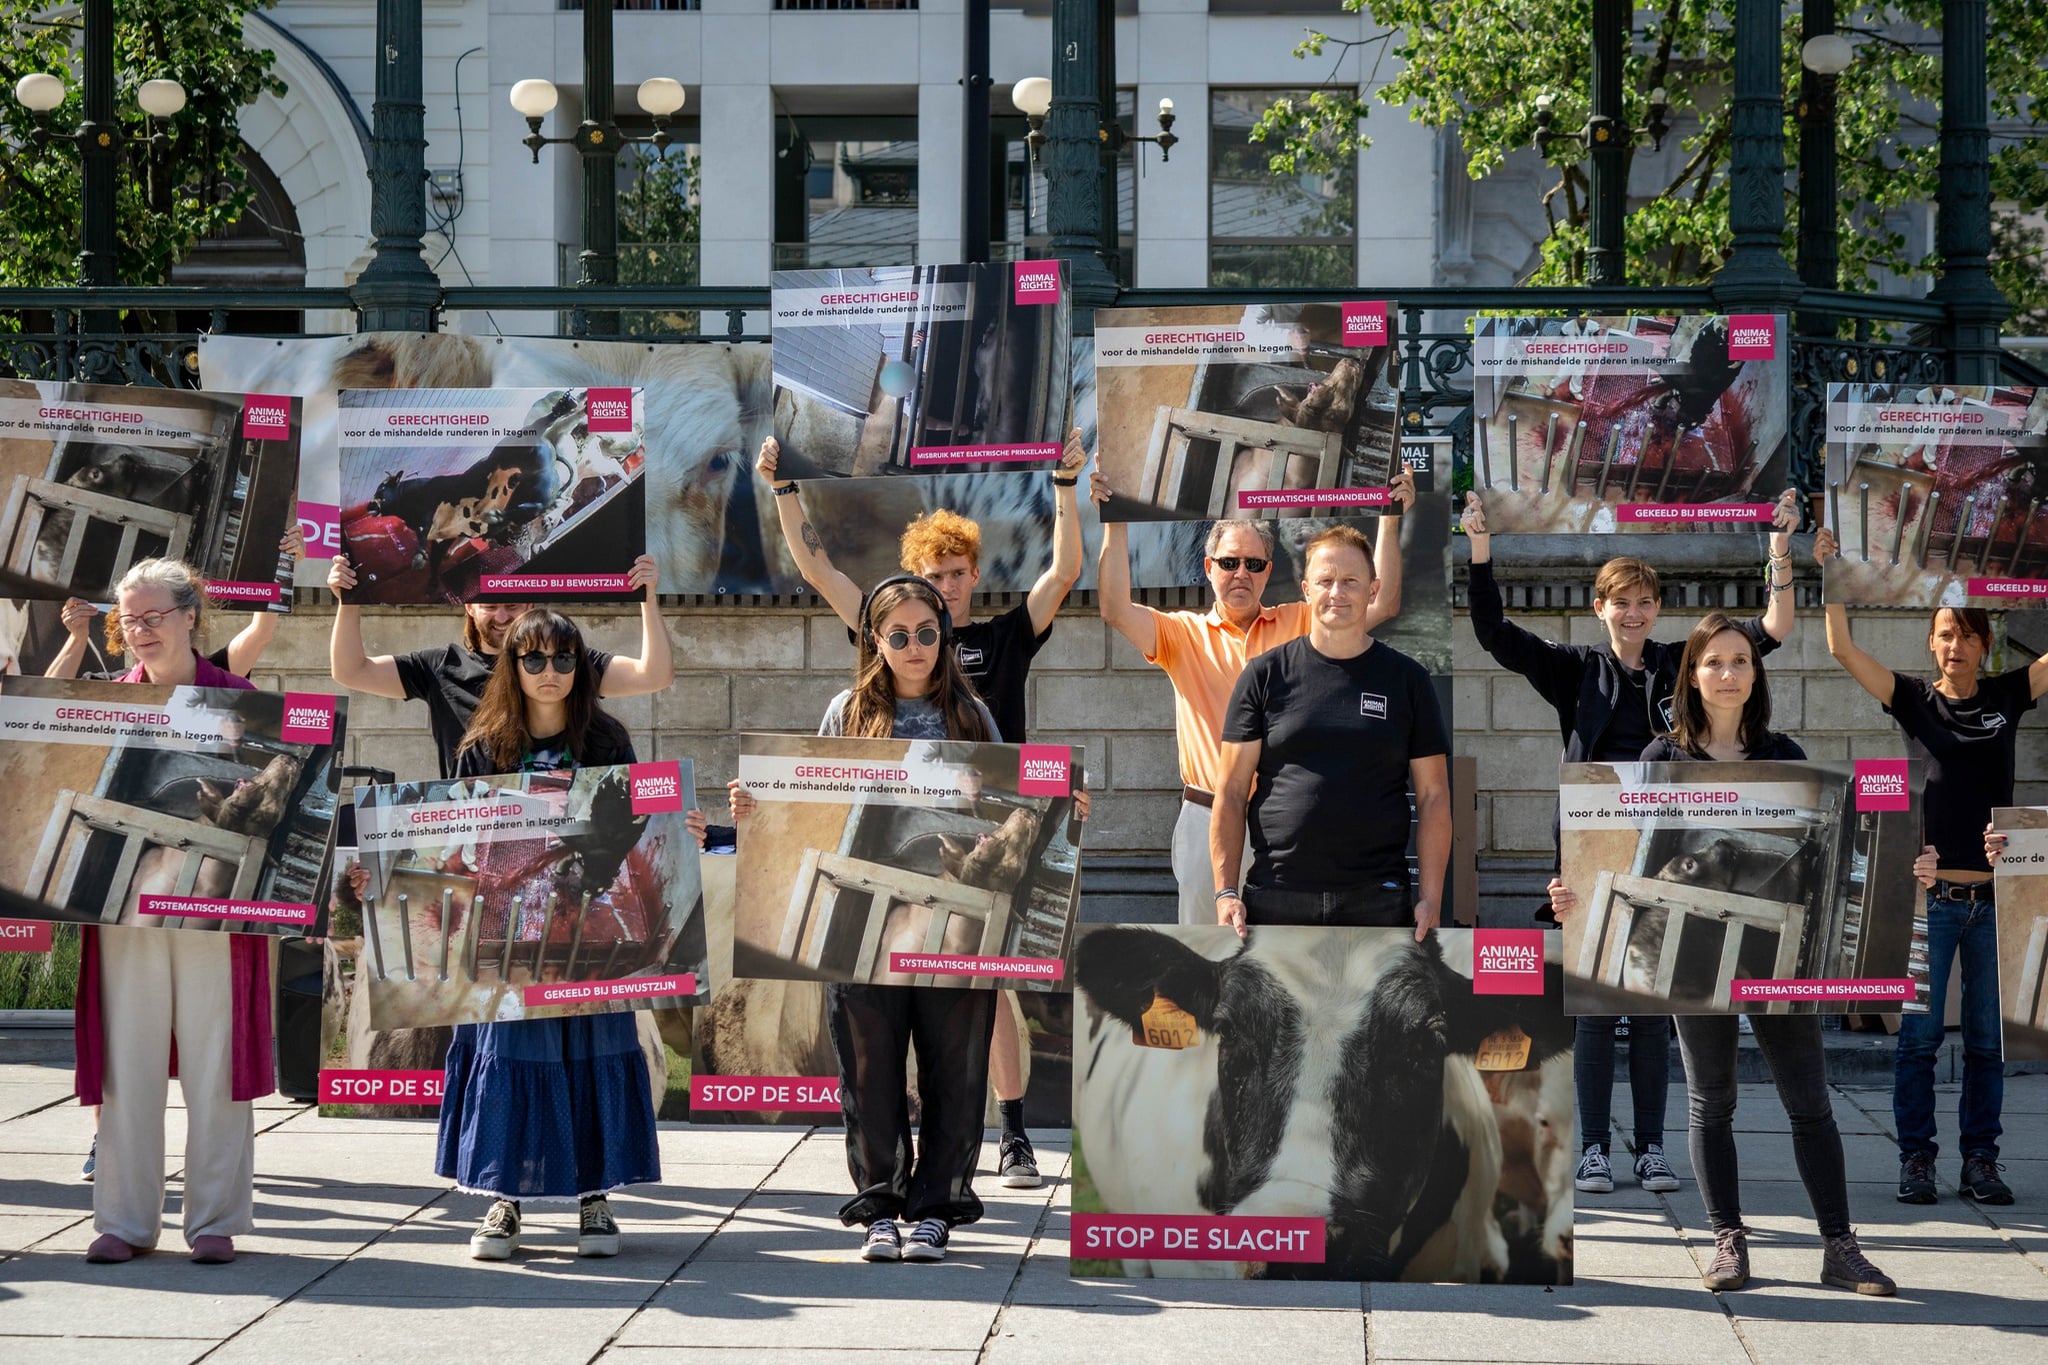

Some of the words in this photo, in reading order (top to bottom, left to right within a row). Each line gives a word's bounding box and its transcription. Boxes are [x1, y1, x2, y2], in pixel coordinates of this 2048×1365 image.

[1019, 273, 1056, 282] ANIMAL
[1021, 281, 1054, 289] RIGHTS
[820, 291, 919, 305] GERECHTIGHEID
[778, 309, 799, 317] voor
[802, 307, 813, 316] de
[816, 305, 874, 316] mishandelde
[876, 304, 918, 313] runderen
[921, 304, 929, 312] in
[933, 303, 966, 313] Izegem
[1346, 315, 1383, 323] ANIMAL
[1348, 322, 1382, 331] RIGHTS
[1145, 332, 1245, 344] GERECHTIGHEID
[1732, 329, 1771, 337] ANIMAL
[1734, 336, 1769, 344] RIGHTS
[1102, 349, 1123, 357] voor
[1126, 347, 1138, 356] de
[1141, 346, 1199, 356] mishandelde
[1202, 345, 1244, 354] runderen
[1247, 345, 1256, 353] in
[1259, 344, 1292, 354] Izegem
[1525, 343, 1628, 354] GERECHTIGHEID
[1506, 357, 1518, 366] de
[1521, 356, 1580, 365] mishandelde
[1584, 357, 1627, 365] runderen
[1630, 357, 1639, 365] in
[1642, 357, 1677, 366] Izegem
[591, 401, 628, 410] ANIMAL
[39, 407, 143, 423] GERECHTIGHEID
[249, 407, 287, 417] ANIMAL
[593, 409, 627, 417] RIGHTS
[1879, 411, 1983, 423] GERECHTIGHEID
[250, 415, 284, 424] RIGHTS
[388, 414, 489, 426] GERECHTIGHEID
[18, 420, 30, 428] de
[33, 421, 94, 432] mishandelde
[98, 425, 141, 436] runderen
[144, 427, 153, 436] in
[156, 429, 191, 439] Izegem
[344, 430, 366, 438] voor
[368, 428, 381, 438] de
[383, 427, 443, 437] mishandelde
[446, 428, 488, 437] runderen
[491, 428, 500, 436] in
[503, 428, 537, 438] Izegem
[1859, 424, 1871, 433] de
[1874, 424, 1935, 434] mishandelde
[1938, 426, 1982, 435] runderen
[1985, 427, 1994, 435] in
[1998, 428, 2033, 438] Izegem
[1011, 448, 1055, 456] PRIKKELAARS
[1247, 495, 1315, 503] SYSTEMATISCHE
[1317, 493, 1382, 501] MISHANDELING
[1635, 509, 1678, 517] GEKEELD
[1681, 509, 1695, 517] BIJ
[1697, 509, 1756, 517] BEWUSTZIJN
[488, 579, 548, 588] OPGETAKELD
[550, 579, 564, 587] BIJ
[567, 579, 623, 587] BEWUSTZIJN
[1986, 583, 2030, 592] GEKEELD
[2033, 584, 2047, 593] BIJ
[205, 585, 272, 596] MISHANDELING
[56, 707, 170, 725] GERECHTIGHEID
[288, 707, 330, 718] ANIMAL
[290, 717, 327, 727] RIGHTS
[5, 720, 29, 729] voor
[32, 720, 46, 731] de
[50, 722, 116, 735] mishandelde
[120, 726, 168, 738] runderen
[172, 730, 181, 739] in
[185, 730, 223, 742] Izegem
[1024, 759, 1066, 770] ANIMAL
[795, 765, 908, 781] GERECHTIGHEID
[1026, 769, 1064, 779] RIGHTS
[634, 777, 677, 788] ANIMAL
[1860, 775, 1904, 783] ANIMAL
[637, 785, 675, 796] RIGHTS
[745, 780, 770, 789] voor
[773, 779, 786, 790] de
[789, 780, 856, 792] mishandelde
[859, 783, 907, 794] runderen
[910, 785, 920, 794] in
[923, 786, 961, 797] Izegem
[1863, 784, 1902, 792] RIGHTS
[1619, 791, 1738, 804] GERECHTIGHEID
[411, 804, 522, 824] GERECHTIGHEID
[1568, 808, 1593, 818] voor
[1597, 807, 1611, 817] de
[1614, 806, 1683, 817] mishandelde
[1688, 807, 1738, 816] runderen
[1742, 807, 1751, 816] in
[1755, 806, 1796, 818] Izegem
[364, 831, 387, 841] voor
[391, 829, 404, 839] de
[407, 822, 472, 837] mishandelde
[476, 820, 522, 831] runderen
[526, 818, 535, 827] in
[538, 815, 576, 828] Izegem
[2002, 855, 2027, 863] voor
[2031, 853, 2045, 862] de
[149, 901, 228, 914] SYSTEMATISCHE
[230, 905, 306, 918] MISHANDELING
[1479, 946, 1538, 957] ANIMAL
[900, 959, 976, 970] SYSTEMATISCHE
[980, 962, 1054, 973] MISHANDELING
[1483, 958, 1535, 970] RIGHTS
[544, 989, 591, 999] GEKEELD
[594, 987, 609, 995] BIJ
[612, 981, 676, 995] BEWUSTZIJN
[1741, 986, 1823, 995] SYSTEMATISCHE
[1826, 985, 1905, 994] MISHANDELING
[330, 1079, 383, 1096] STOP
[390, 1080, 416, 1096] DE
[702, 1085, 756, 1102] STOP
[762, 1086, 789, 1102] DE
[1086, 1226, 1154, 1248] STOP
[1164, 1227, 1199, 1249] DE
[1208, 1228, 1310, 1251] SLACHT
